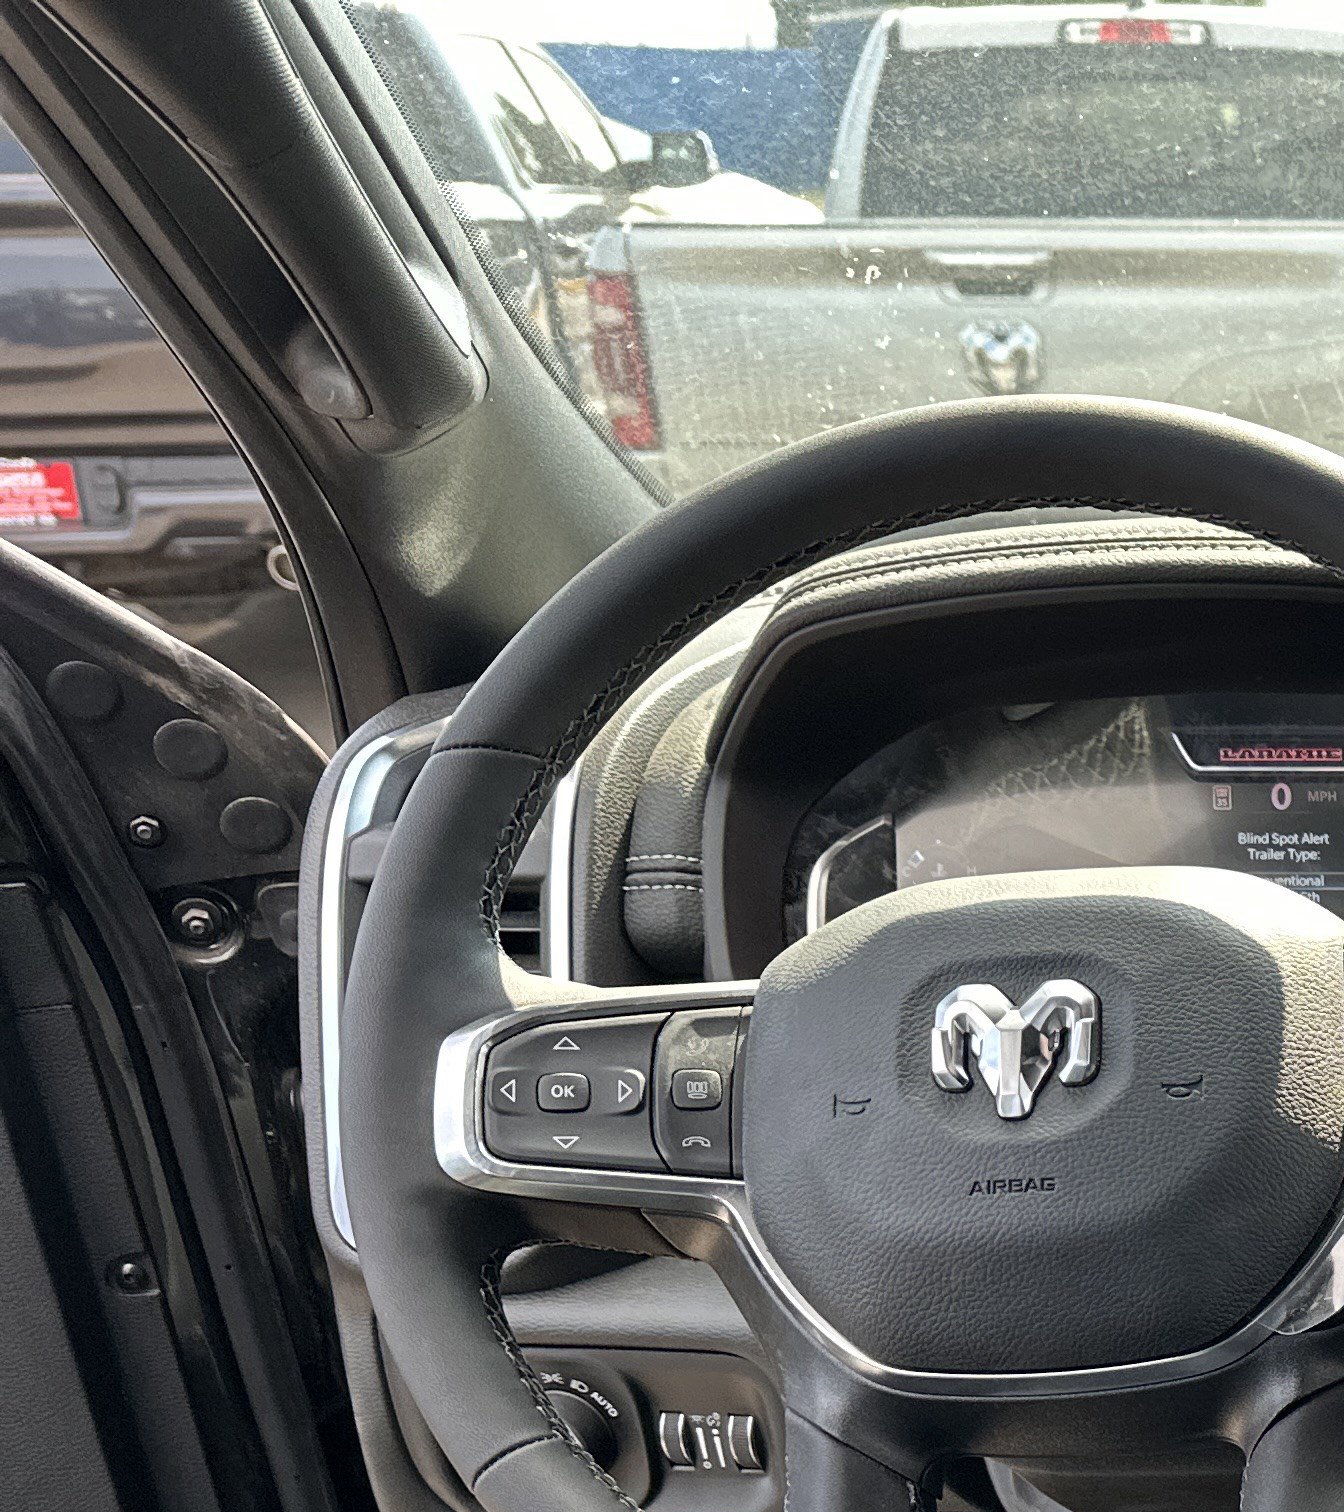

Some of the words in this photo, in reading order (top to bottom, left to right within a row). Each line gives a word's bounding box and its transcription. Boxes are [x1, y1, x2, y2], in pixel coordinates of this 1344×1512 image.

[1271, 782, 1292, 810] 0
[1307, 790, 1337, 803] MPH
[1237, 832, 1270, 845] Blind
[1271, 832, 1299, 848] Spot
[1301, 831, 1330, 845] Alert
[1247, 849, 1286, 861] Trailer
[1288, 850, 1321, 863] Type:
[550, 1084, 576, 1099] OK
[968, 1177, 1056, 1196] AIRBAG
[590, 1391, 619, 1418] AUTO
